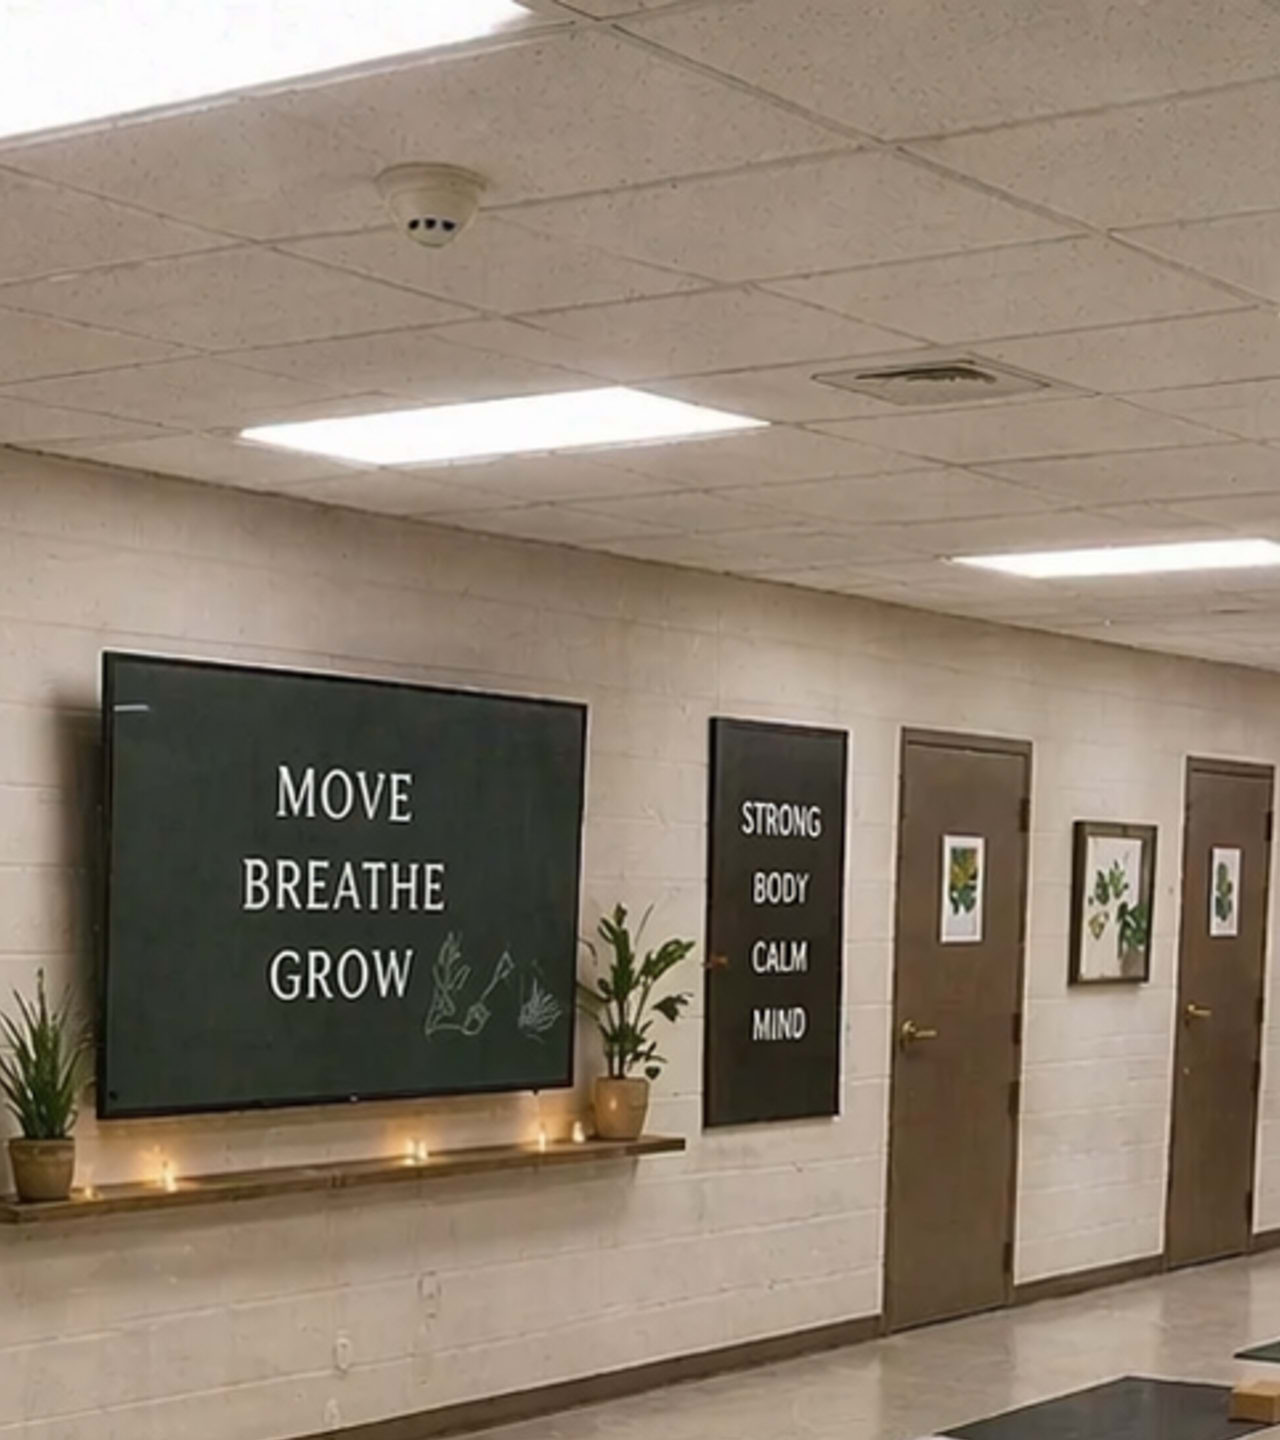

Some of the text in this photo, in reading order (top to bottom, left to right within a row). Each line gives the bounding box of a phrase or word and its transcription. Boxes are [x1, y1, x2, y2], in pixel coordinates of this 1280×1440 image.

[276, 765, 413, 822] MOVE
[741, 800, 822, 838] STRONG
[243, 858, 445, 911] BREATHE
[753, 871, 810, 904] BODY
[269, 948, 414, 1001] GROW
[752, 940, 808, 973] CALM
[753, 1007, 806, 1041] MIND
